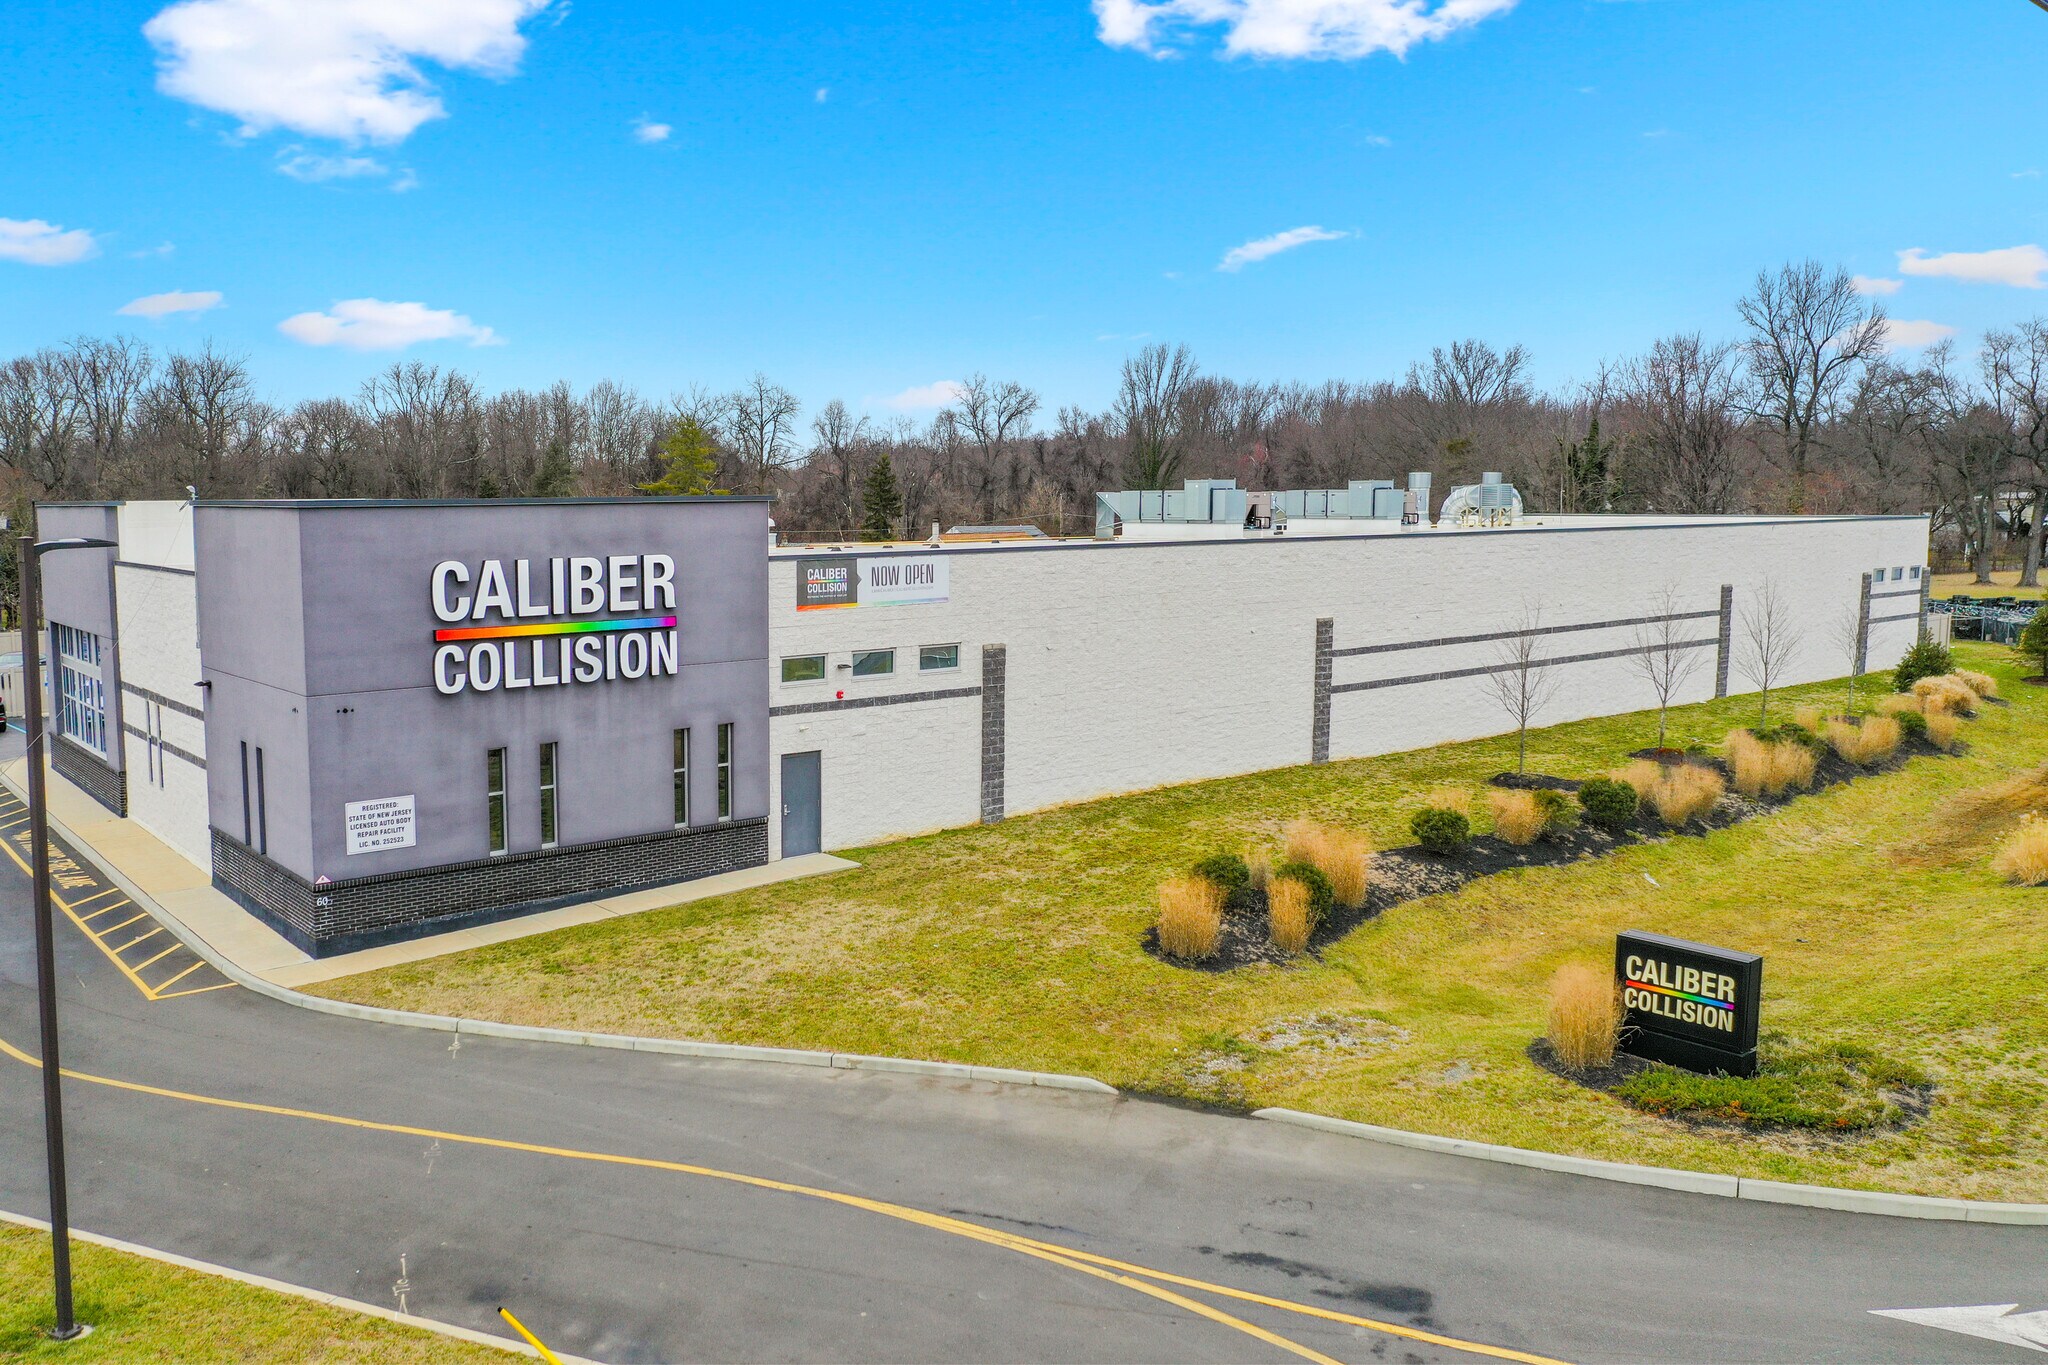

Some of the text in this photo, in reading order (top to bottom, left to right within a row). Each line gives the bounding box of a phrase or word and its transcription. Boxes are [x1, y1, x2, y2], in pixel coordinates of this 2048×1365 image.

[807, 567, 847, 580] CALIBER
[871, 563, 934, 587] NOW OPEN
[431, 554, 677, 623] CALIBER
[807, 582, 848, 593] COLLISION
[433, 630, 678, 694] COLLISION
[362, 802, 399, 811] REGISTERED:
[391, 809, 412, 817] JERSEY
[350, 821, 378, 830] LICENSED
[358, 827, 405, 838] REPAIR FACILITY
[1625, 954, 1736, 1003] CALIBER
[1624, 987, 1734, 1032] COLLISION
